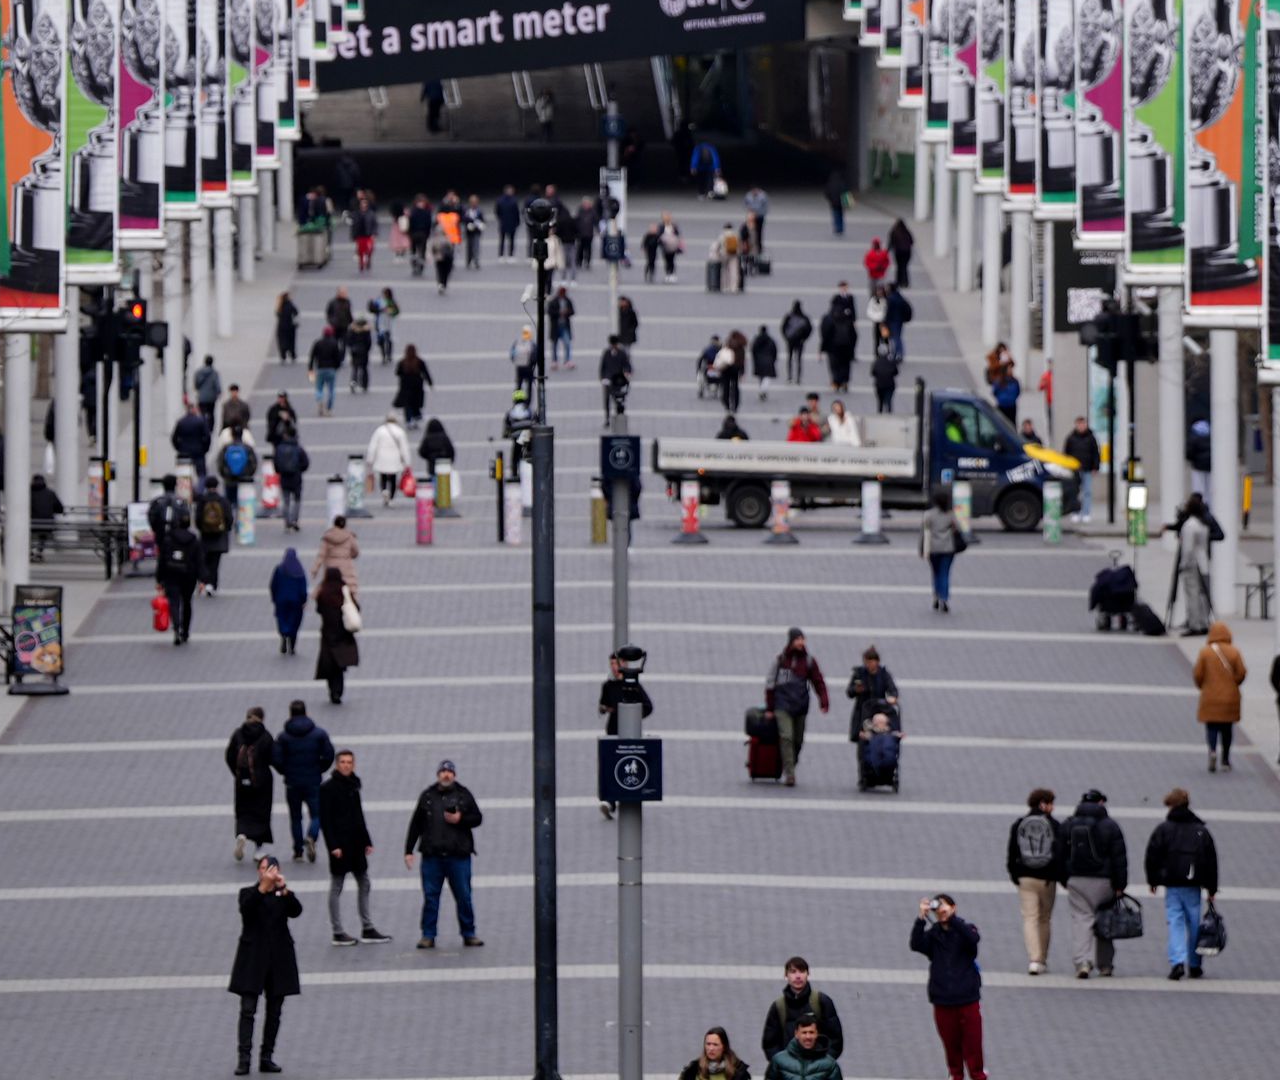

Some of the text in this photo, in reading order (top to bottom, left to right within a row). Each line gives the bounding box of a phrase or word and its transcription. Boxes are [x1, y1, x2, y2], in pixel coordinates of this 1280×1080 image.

[333, 1, 610, 59] et a smart meter
